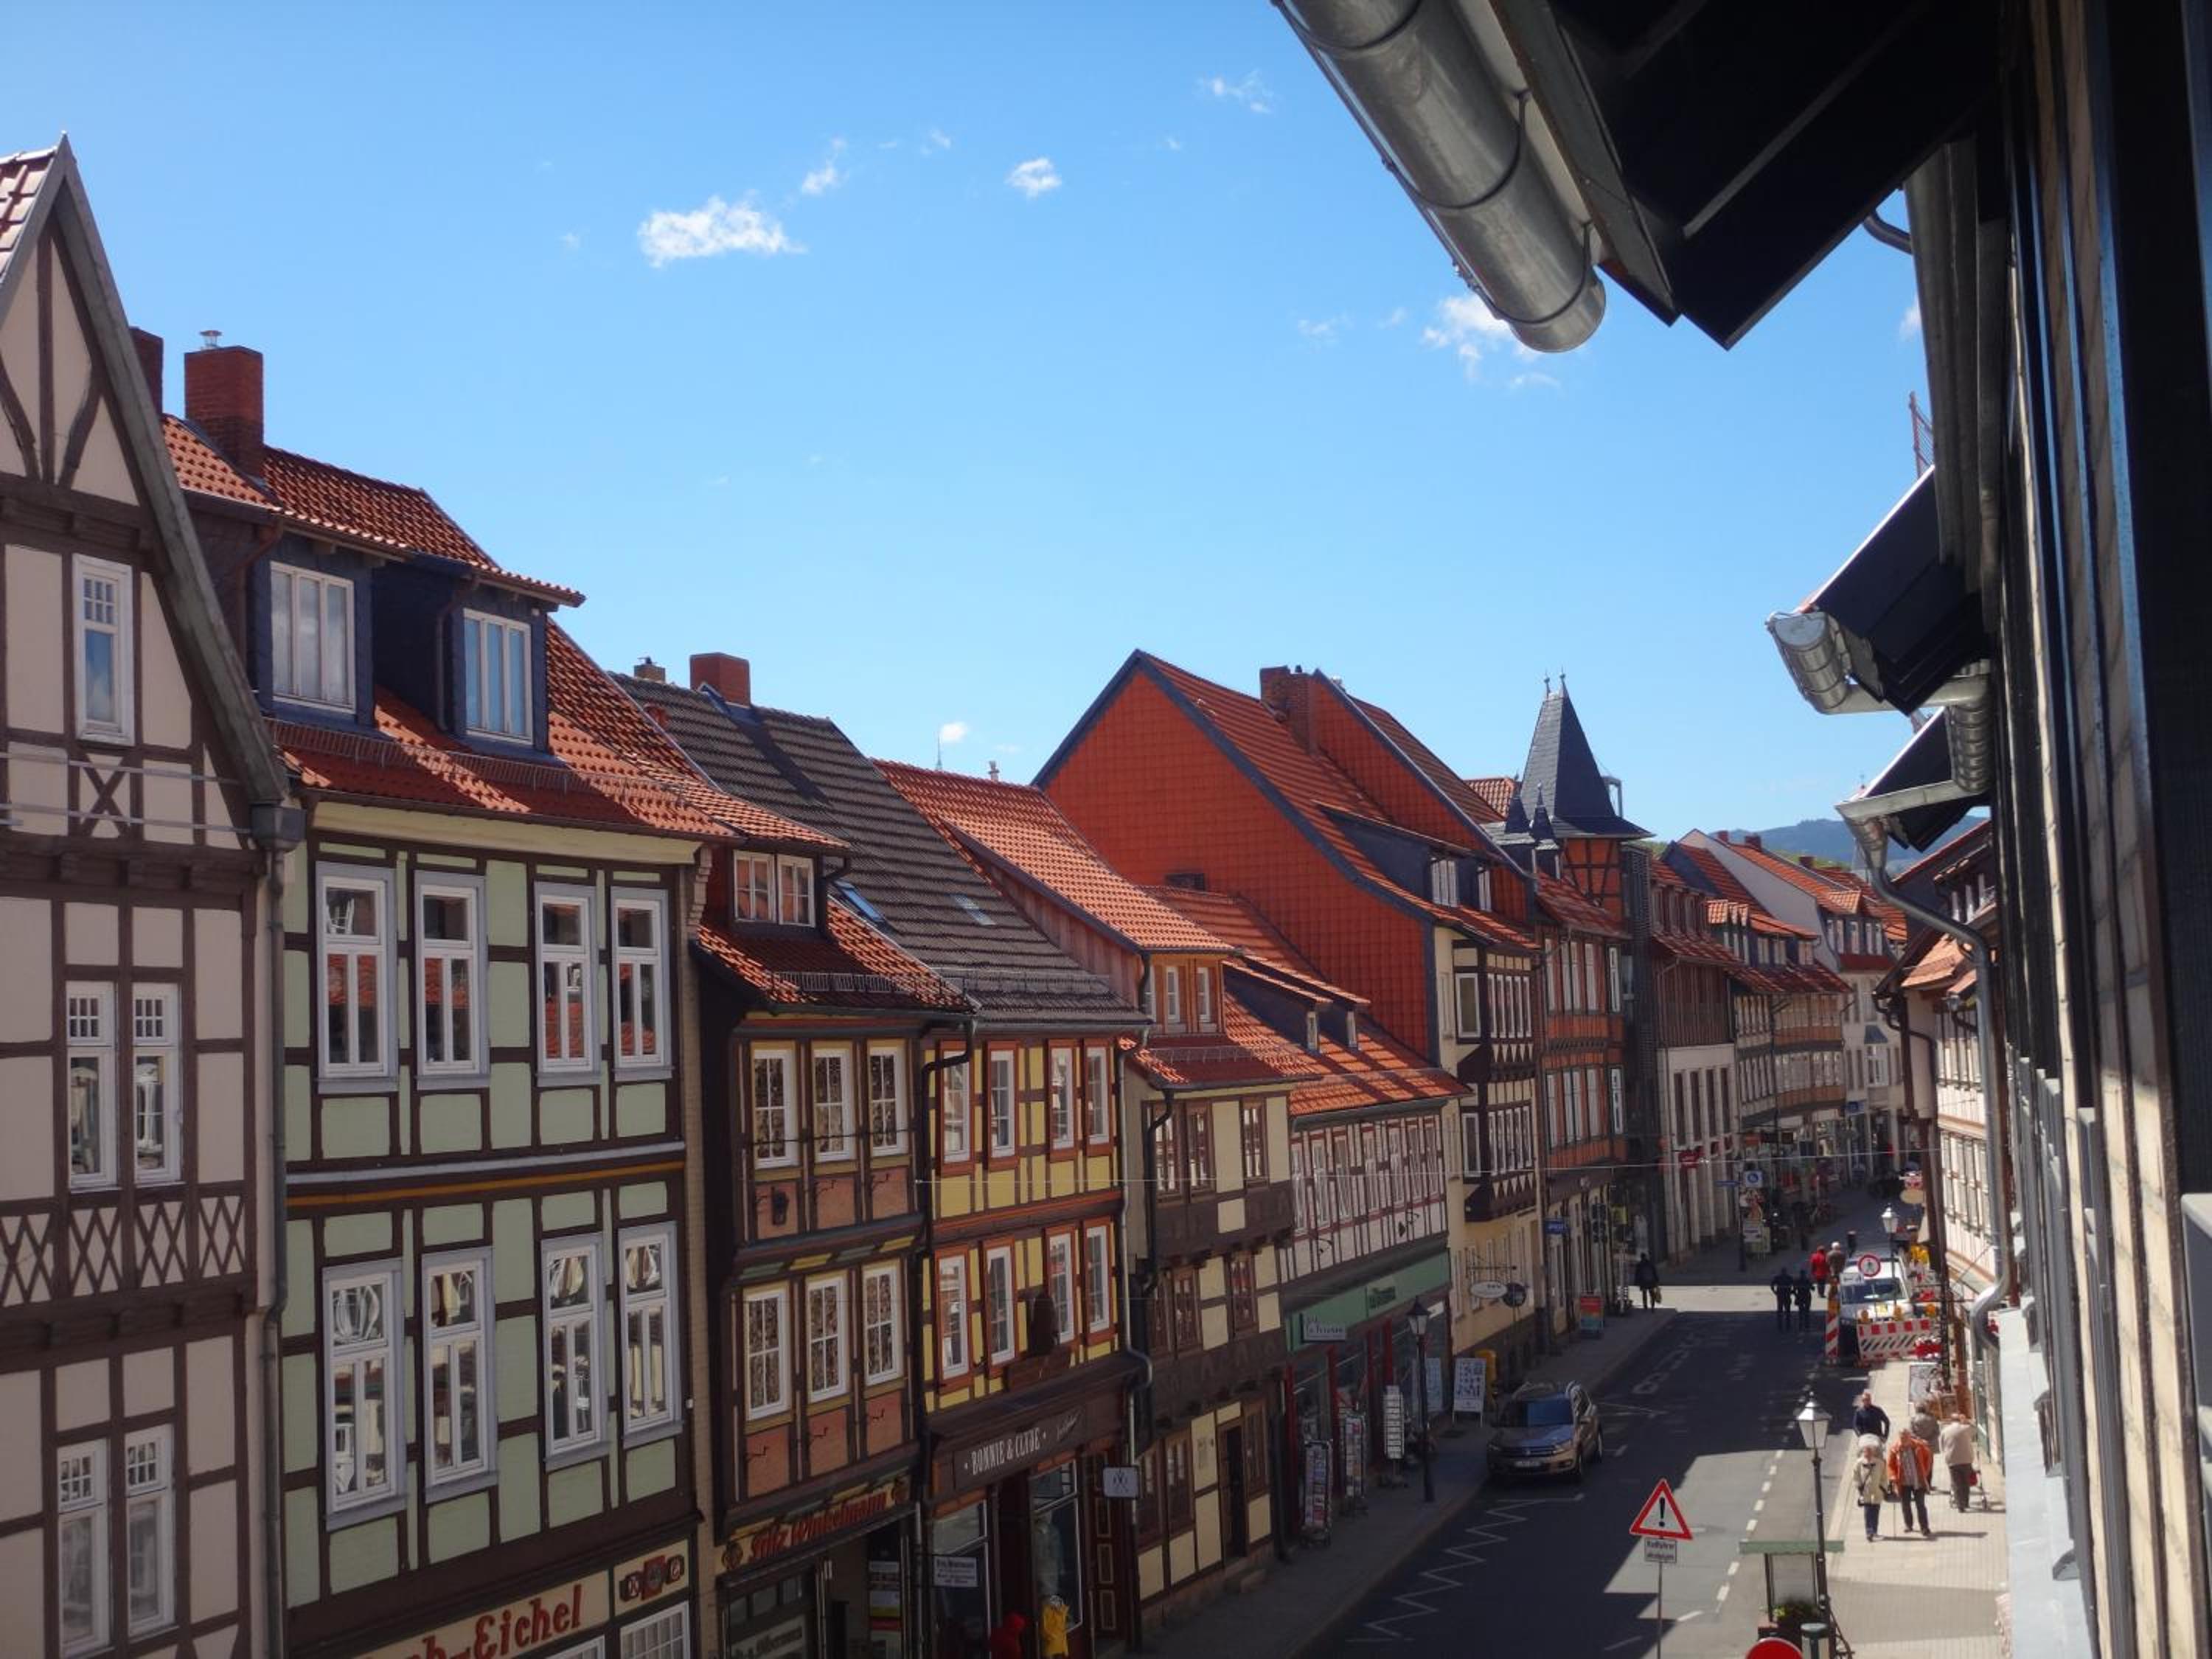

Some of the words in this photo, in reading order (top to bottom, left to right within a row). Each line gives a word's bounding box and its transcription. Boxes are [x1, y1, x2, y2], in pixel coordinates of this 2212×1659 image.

[971, 1439, 1005, 1475] BONNIE
[1006, 1438, 1015, 1461] &
[1015, 1427, 1041, 1458] CLYDE
